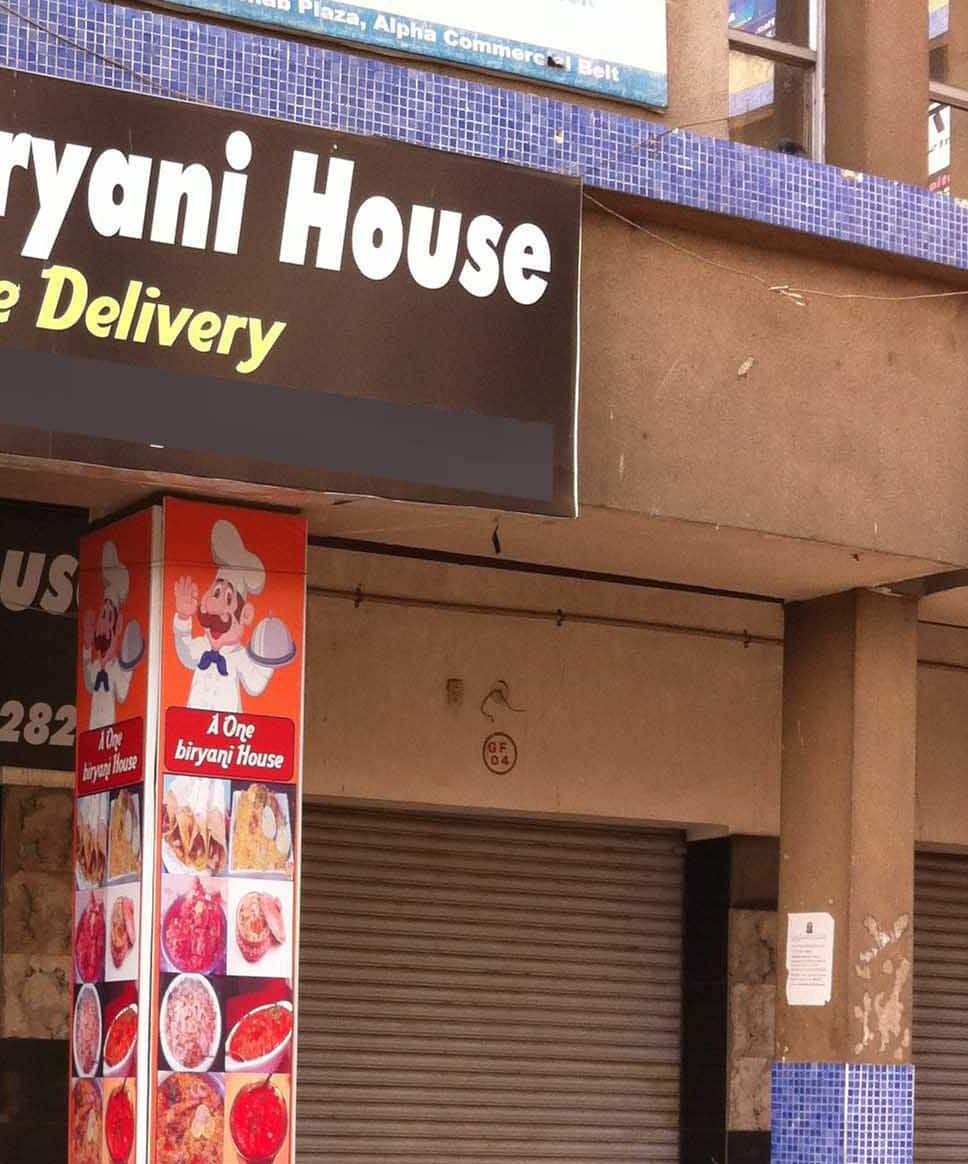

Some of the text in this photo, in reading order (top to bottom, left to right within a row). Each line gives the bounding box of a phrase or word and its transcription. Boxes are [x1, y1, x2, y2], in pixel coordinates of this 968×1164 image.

[298, 0, 367, 32] Plaza,
[373, 14, 437, 42] Alpha
[443, 29, 572, 73] Commercal
[578, 57, 620, 82] Belt
[280, 150, 551, 305] House
[36, 265, 287, 374] Delivery
[97, 727, 123, 752] A One
[207, 713, 256, 742] A One
[82, 752, 138, 784] biryani House
[174, 739, 285, 769] biryani House
